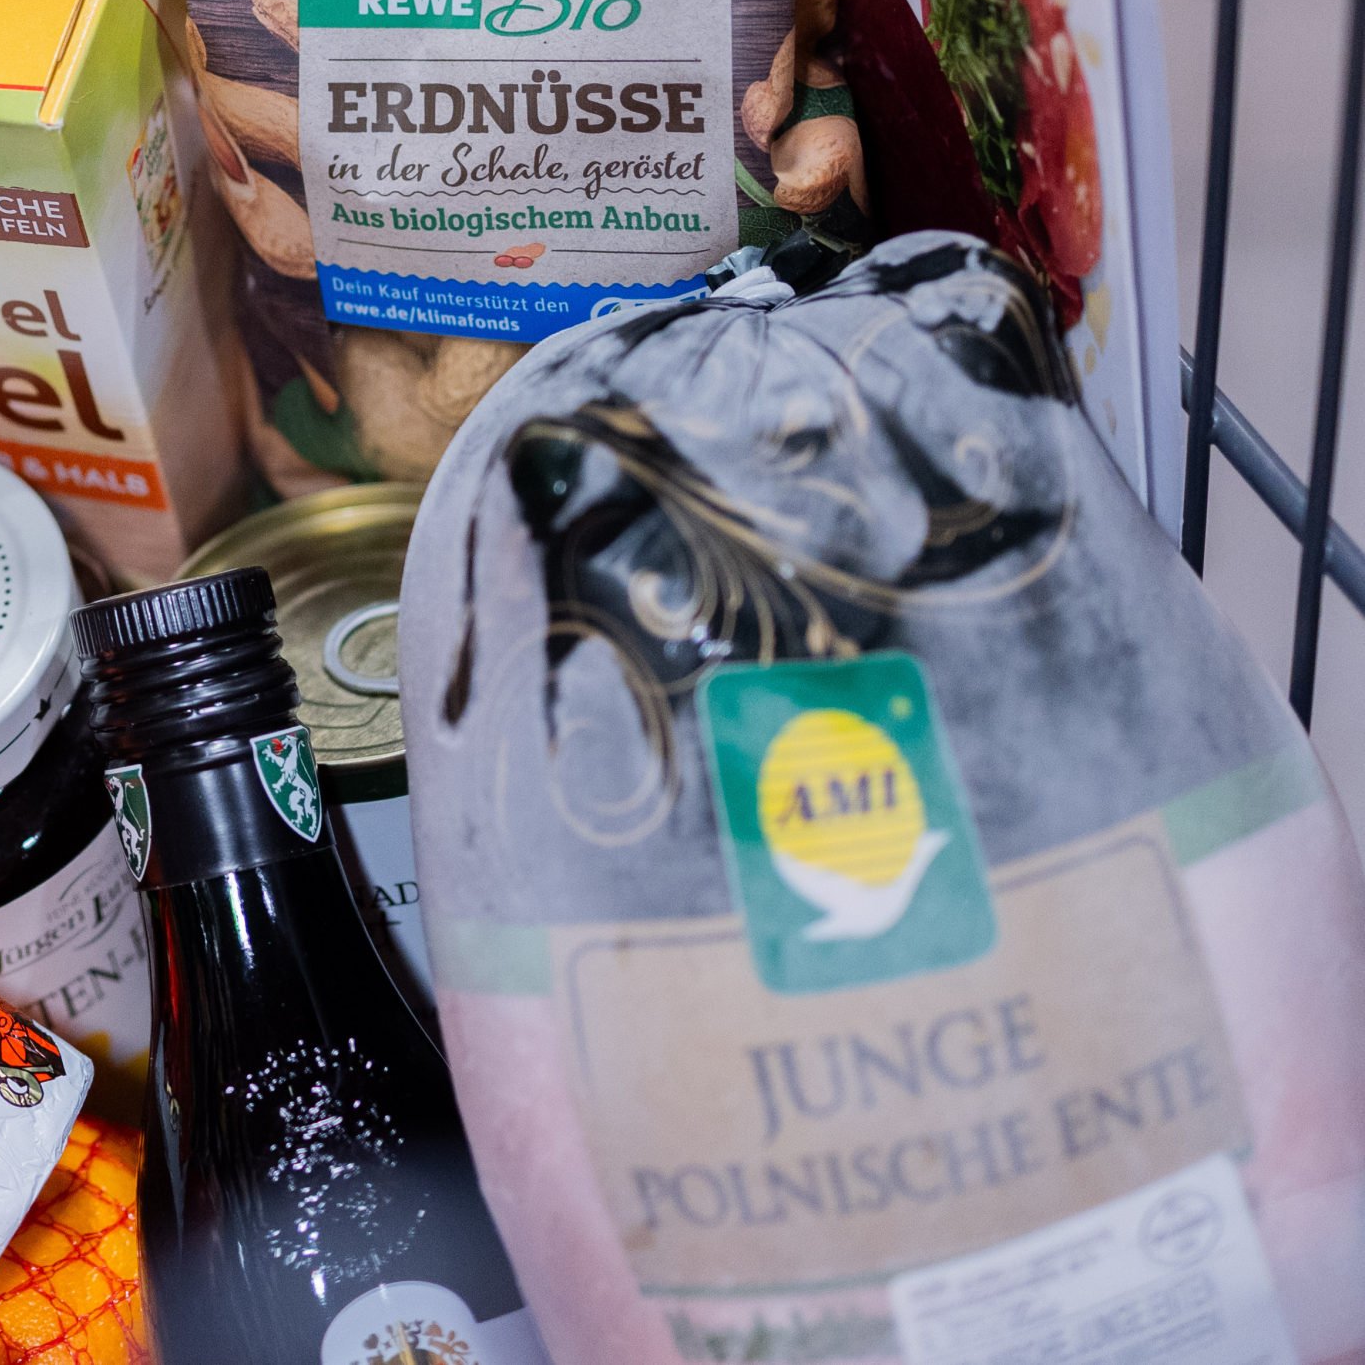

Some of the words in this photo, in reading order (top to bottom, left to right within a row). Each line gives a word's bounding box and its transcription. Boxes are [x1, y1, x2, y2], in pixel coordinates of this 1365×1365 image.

[327, 69, 704, 135] ERDNÜSSE
[328, 155, 361, 180] in
[377, 144, 430, 181] der
[441, 142, 569, 186] Schale,
[583, 150, 706, 200] geröstet
[331, 204, 384, 227] Aus
[390, 205, 593, 236] biologischem
[600, 206, 711, 232] Anbau.
[332, 277, 372, 295] Dein
[378, 280, 419, 301] Kauf
[425, 290, 529, 312] unterstützt
[535, 297, 570, 313] den
[335, 300, 521, 333] rewe.de/klimafonds
[54, 462, 149, 497] HALB
[774, 768, 902, 828] AMI
[22, 926, 147, 1028] TEN-
[746, 993, 1048, 1145] JUNGE
[633, 1110, 1046, 1234] POLNISCHE
[1053, 1043, 1220, 1160] ENTE
